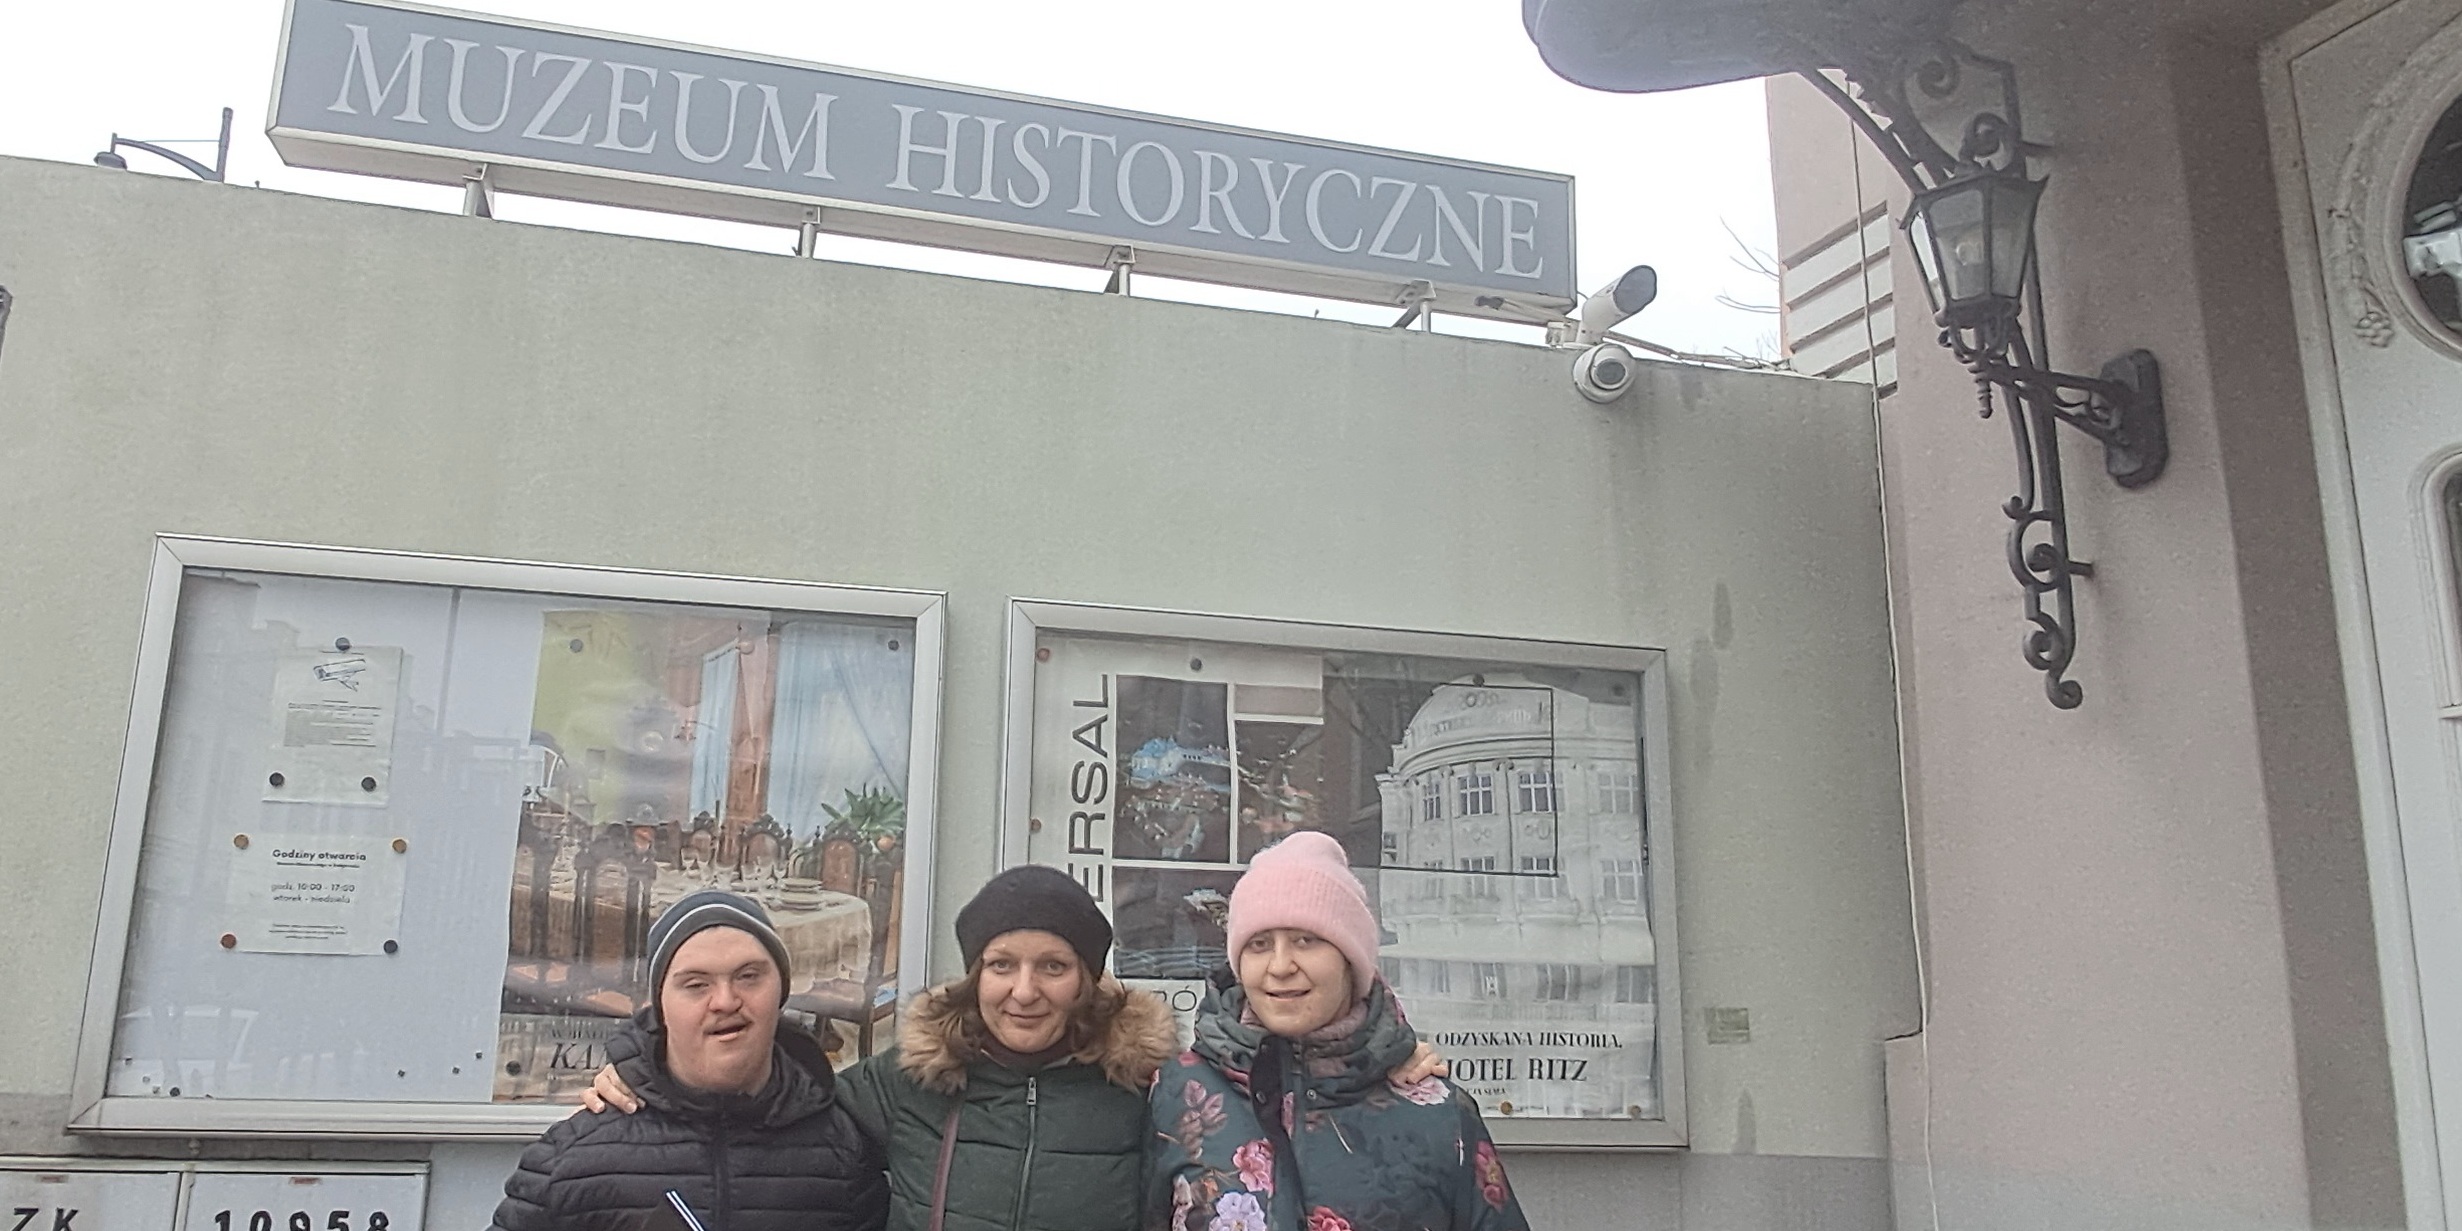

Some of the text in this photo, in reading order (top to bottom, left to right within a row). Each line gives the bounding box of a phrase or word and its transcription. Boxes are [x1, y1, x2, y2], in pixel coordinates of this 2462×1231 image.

[327, 23, 1545, 279] MUZEUM HISTORYCZNE
[272, 849, 366, 861] Godziny otwarcia
[1436, 1032, 1533, 1046] ODZYSKANA
[1528, 1058, 1588, 1081] RITZ
